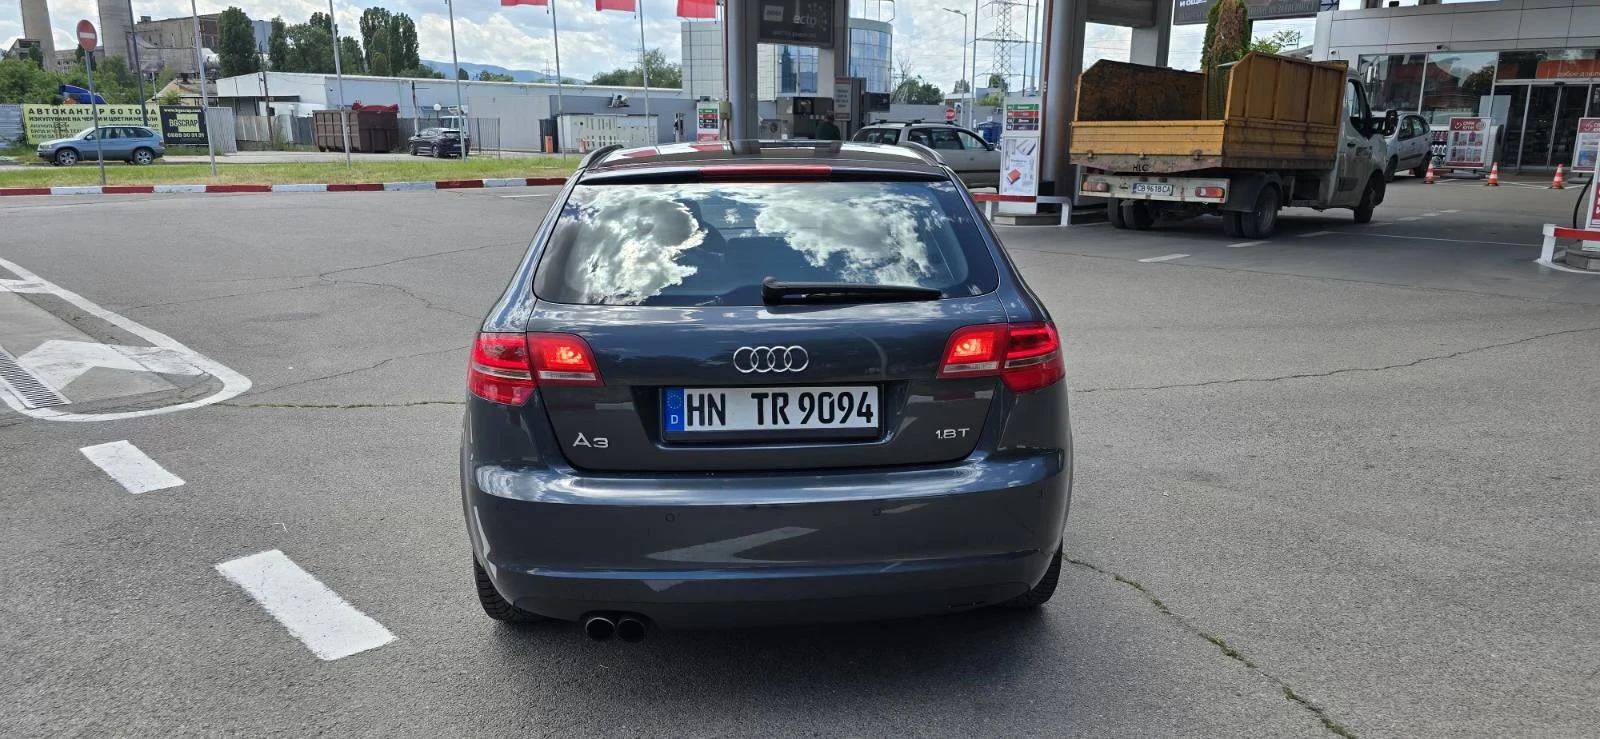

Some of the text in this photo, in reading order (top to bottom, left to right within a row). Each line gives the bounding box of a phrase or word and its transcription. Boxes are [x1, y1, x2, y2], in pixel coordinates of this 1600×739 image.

[687, 391, 874, 426] HN TR 9094
[670, 414, 679, 424] D
[572, 432, 609, 448] A3
